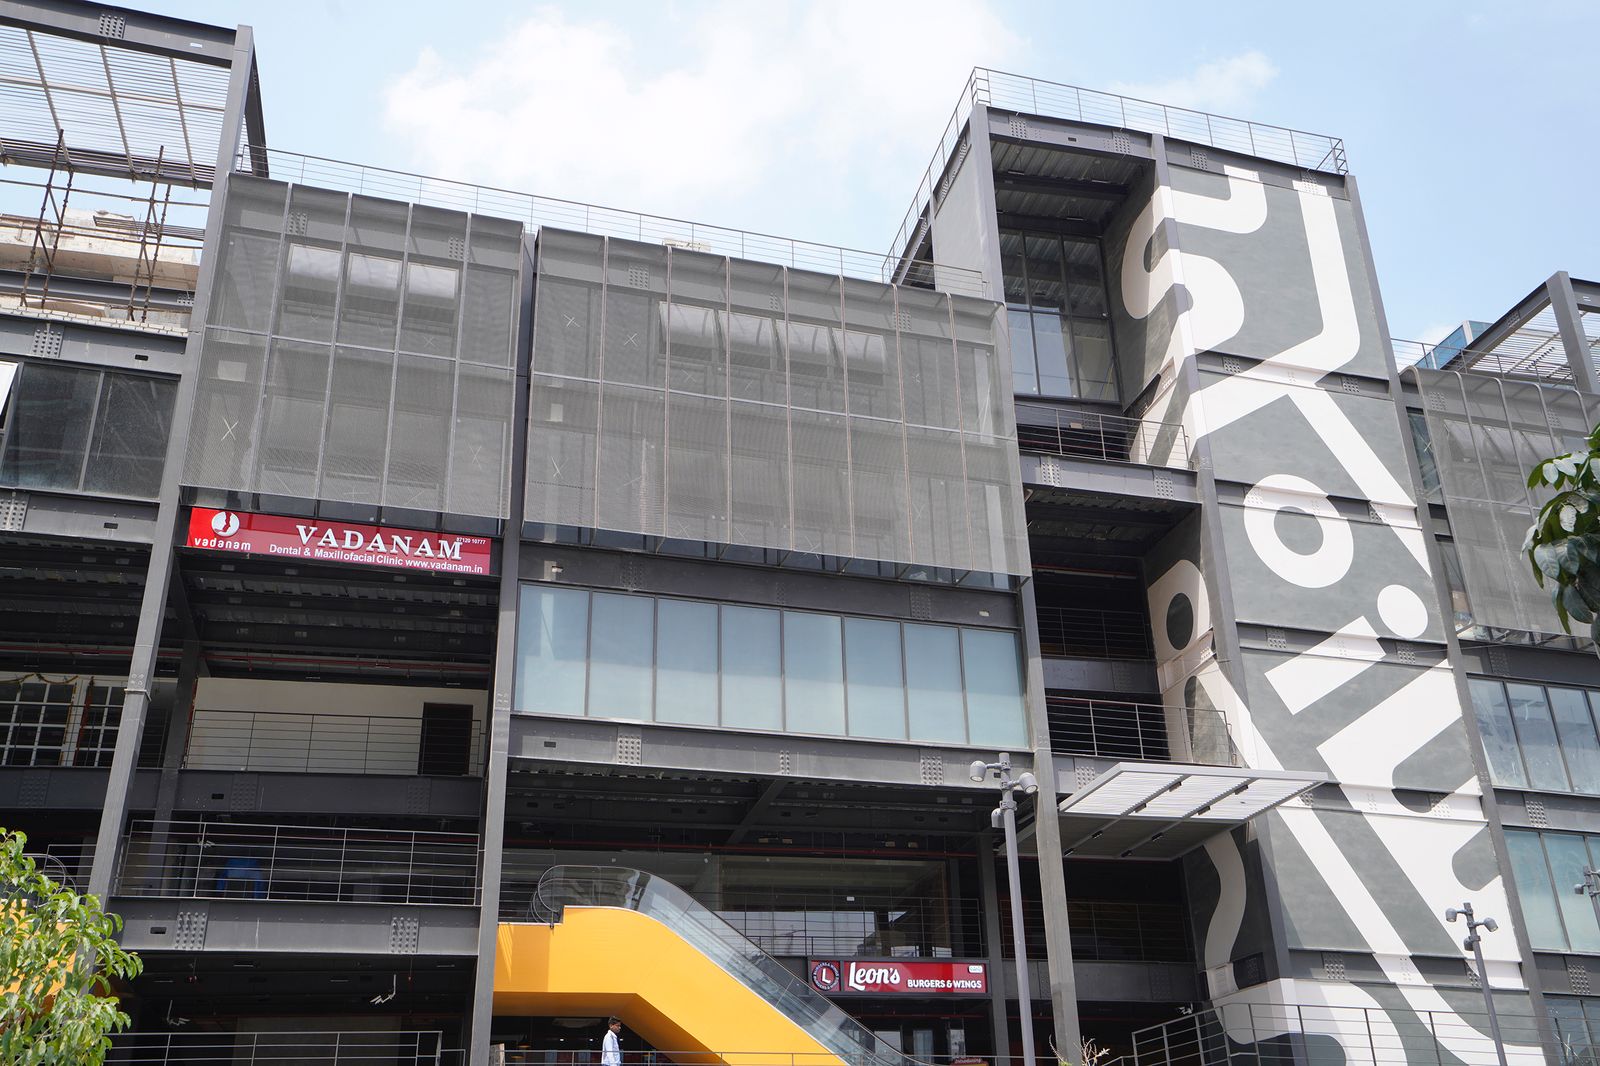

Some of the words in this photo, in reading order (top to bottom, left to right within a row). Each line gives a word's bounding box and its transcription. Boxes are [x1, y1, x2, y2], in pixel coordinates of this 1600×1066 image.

[194, 537, 251, 551] vadanam
[296, 525, 462, 560] VADANAM
[269, 544, 301, 556] Dental
[304, 547, 311, 557] &
[315, 548, 375, 563] Maxillofacial
[376, 555, 403, 566] Clinic
[405, 559, 483, 574] www.vadanam.in
[822, 968, 831, 984] L
[849, 961, 901, 991] Leon's
[907, 979, 945, 988] BURGERS
[946, 980, 953, 988] &
[953, 980, 982, 989] WINGS
